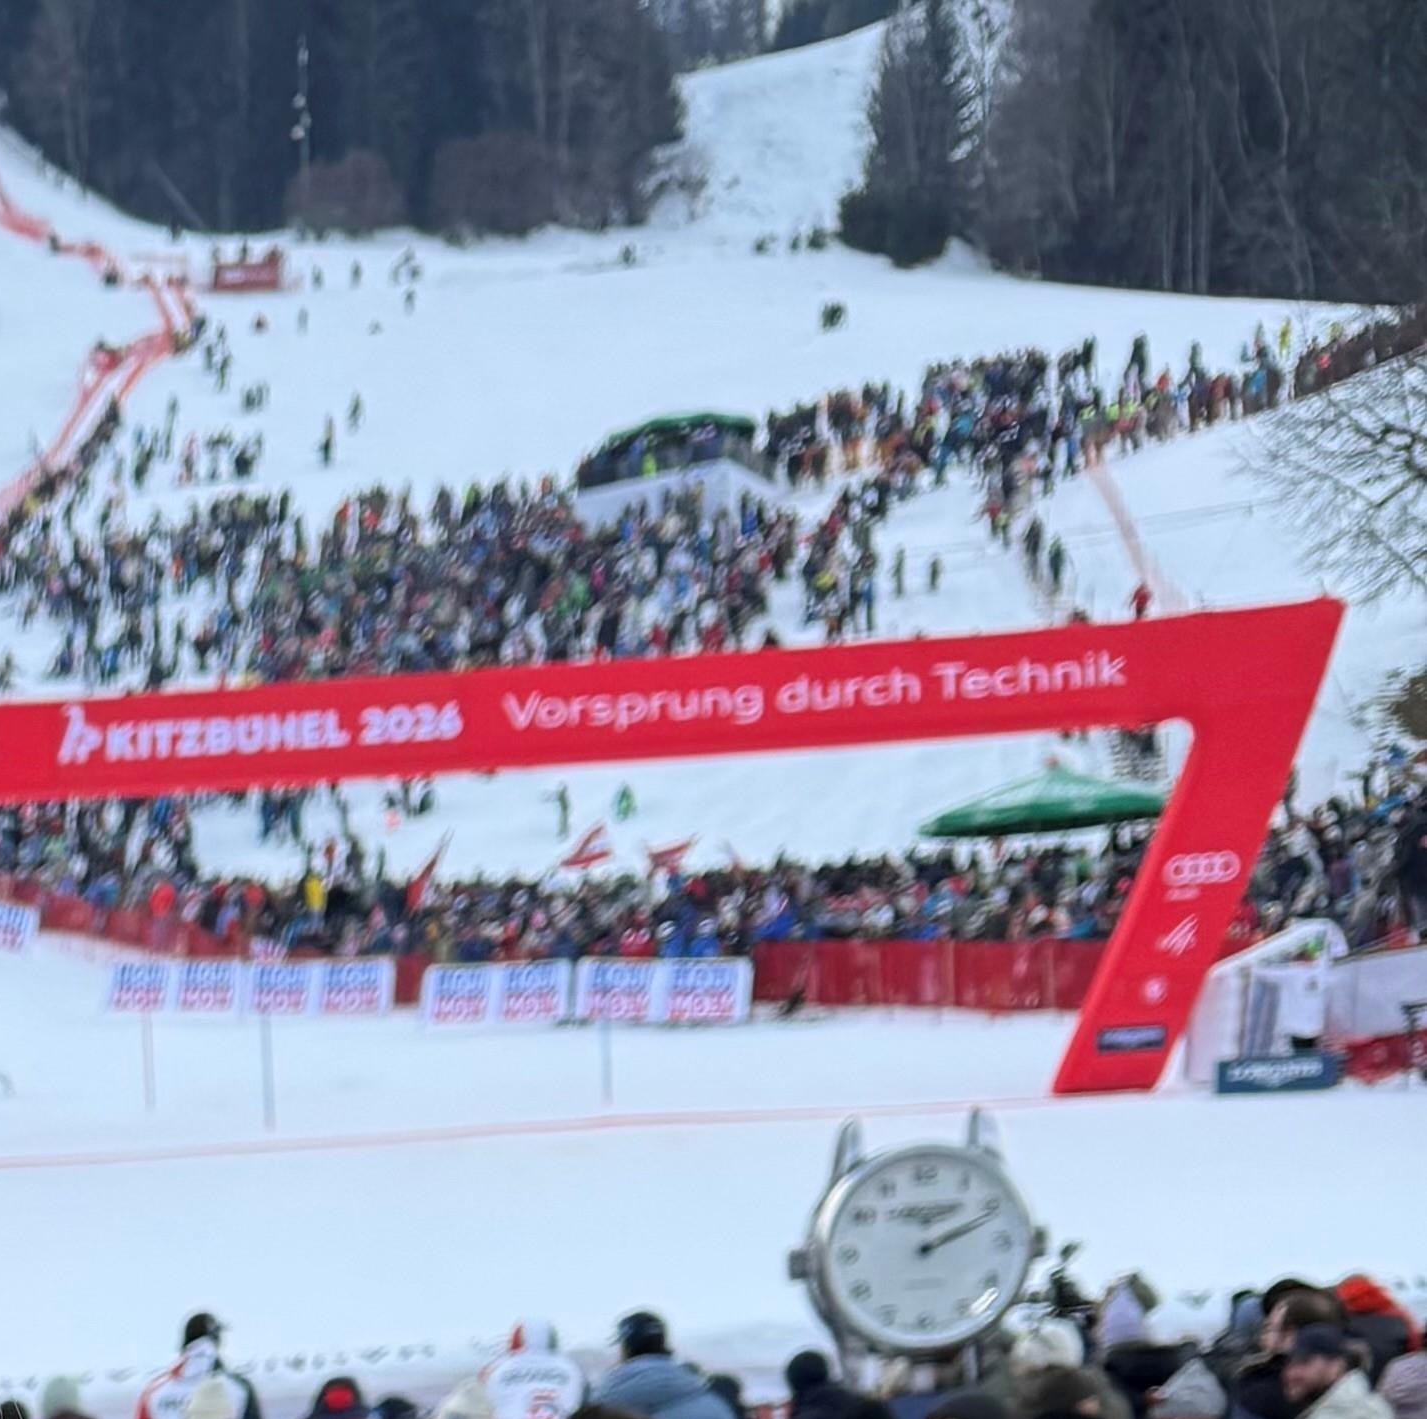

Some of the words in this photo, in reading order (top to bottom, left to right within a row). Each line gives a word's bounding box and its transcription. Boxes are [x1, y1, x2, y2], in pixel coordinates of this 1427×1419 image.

[358, 699, 465, 746] 2026
[504, 682, 764, 732] Vorsprung
[777, 670, 921, 715] durch
[931, 650, 1127, 702] Technik
